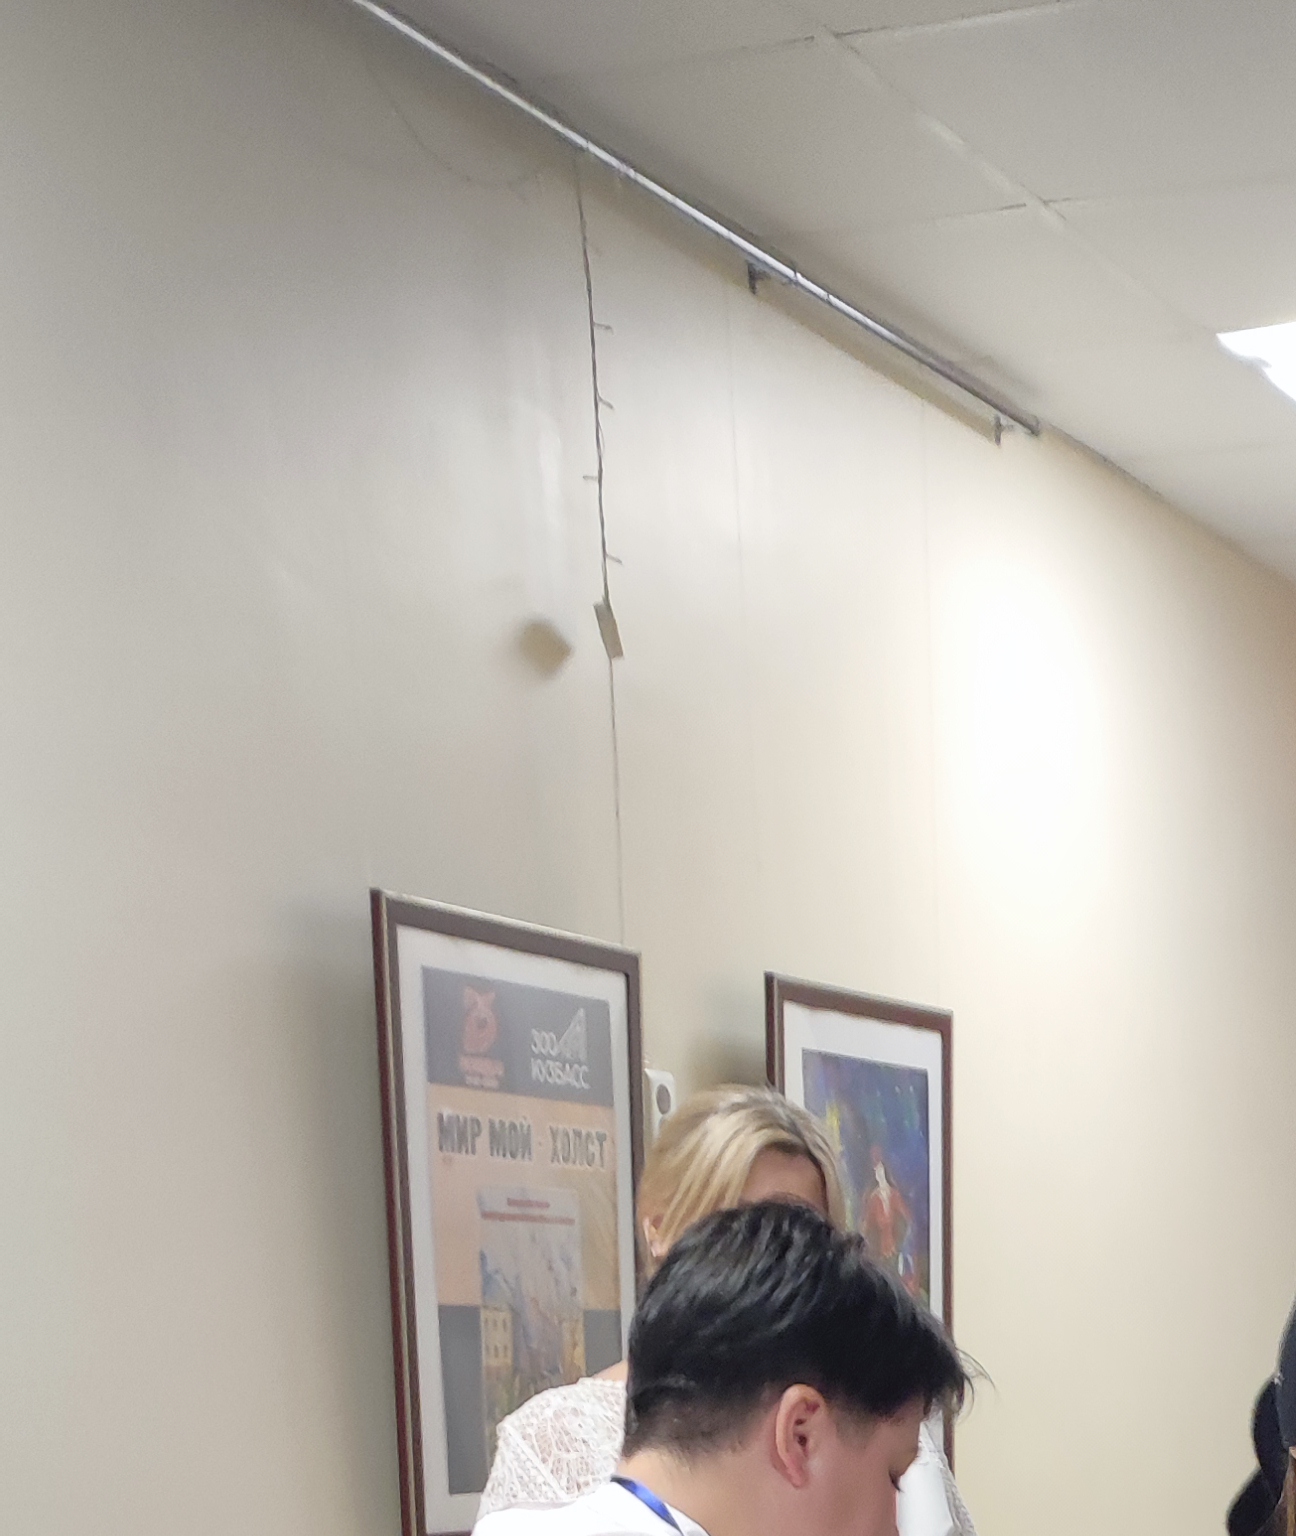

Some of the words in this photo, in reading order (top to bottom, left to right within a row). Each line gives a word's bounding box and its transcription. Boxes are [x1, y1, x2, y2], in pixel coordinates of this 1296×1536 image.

[437, 1112, 482, 1156] МИР
[488, 1116, 533, 1162] МОЙ
[549, 1124, 607, 1171] ХОЛСТ
